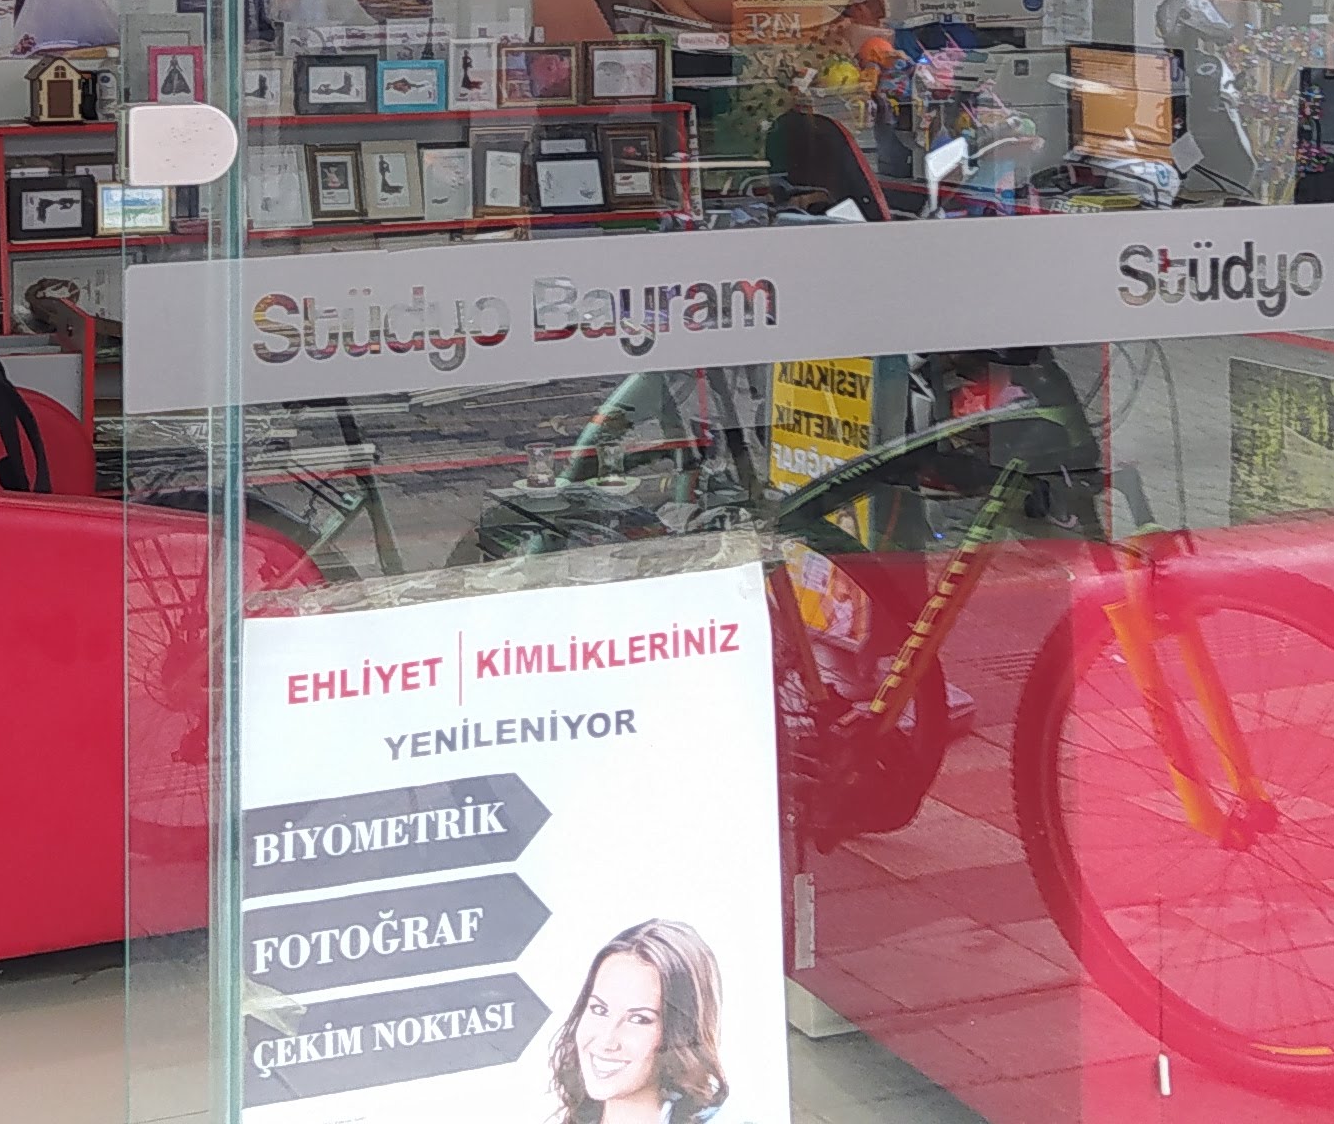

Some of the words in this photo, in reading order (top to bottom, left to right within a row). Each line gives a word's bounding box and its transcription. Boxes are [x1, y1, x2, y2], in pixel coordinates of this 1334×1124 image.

[1116, 239, 1324, 318] Stüdyo
[252, 284, 513, 373] Stüdyo
[533, 276, 778, 358] Bayram
[286, 654, 444, 706] EHLİYET
[475, 618, 741, 680] KİMLİKLERİNİZ
[384, 708, 638, 762] YENİLENİYOR
[252, 795, 508, 868] BİYOMETRİK
[250, 906, 485, 977] FOTOĞRAF
[253, 1026, 363, 1079] ÇEKİM
[373, 1001, 517, 1048] NOKTASI
